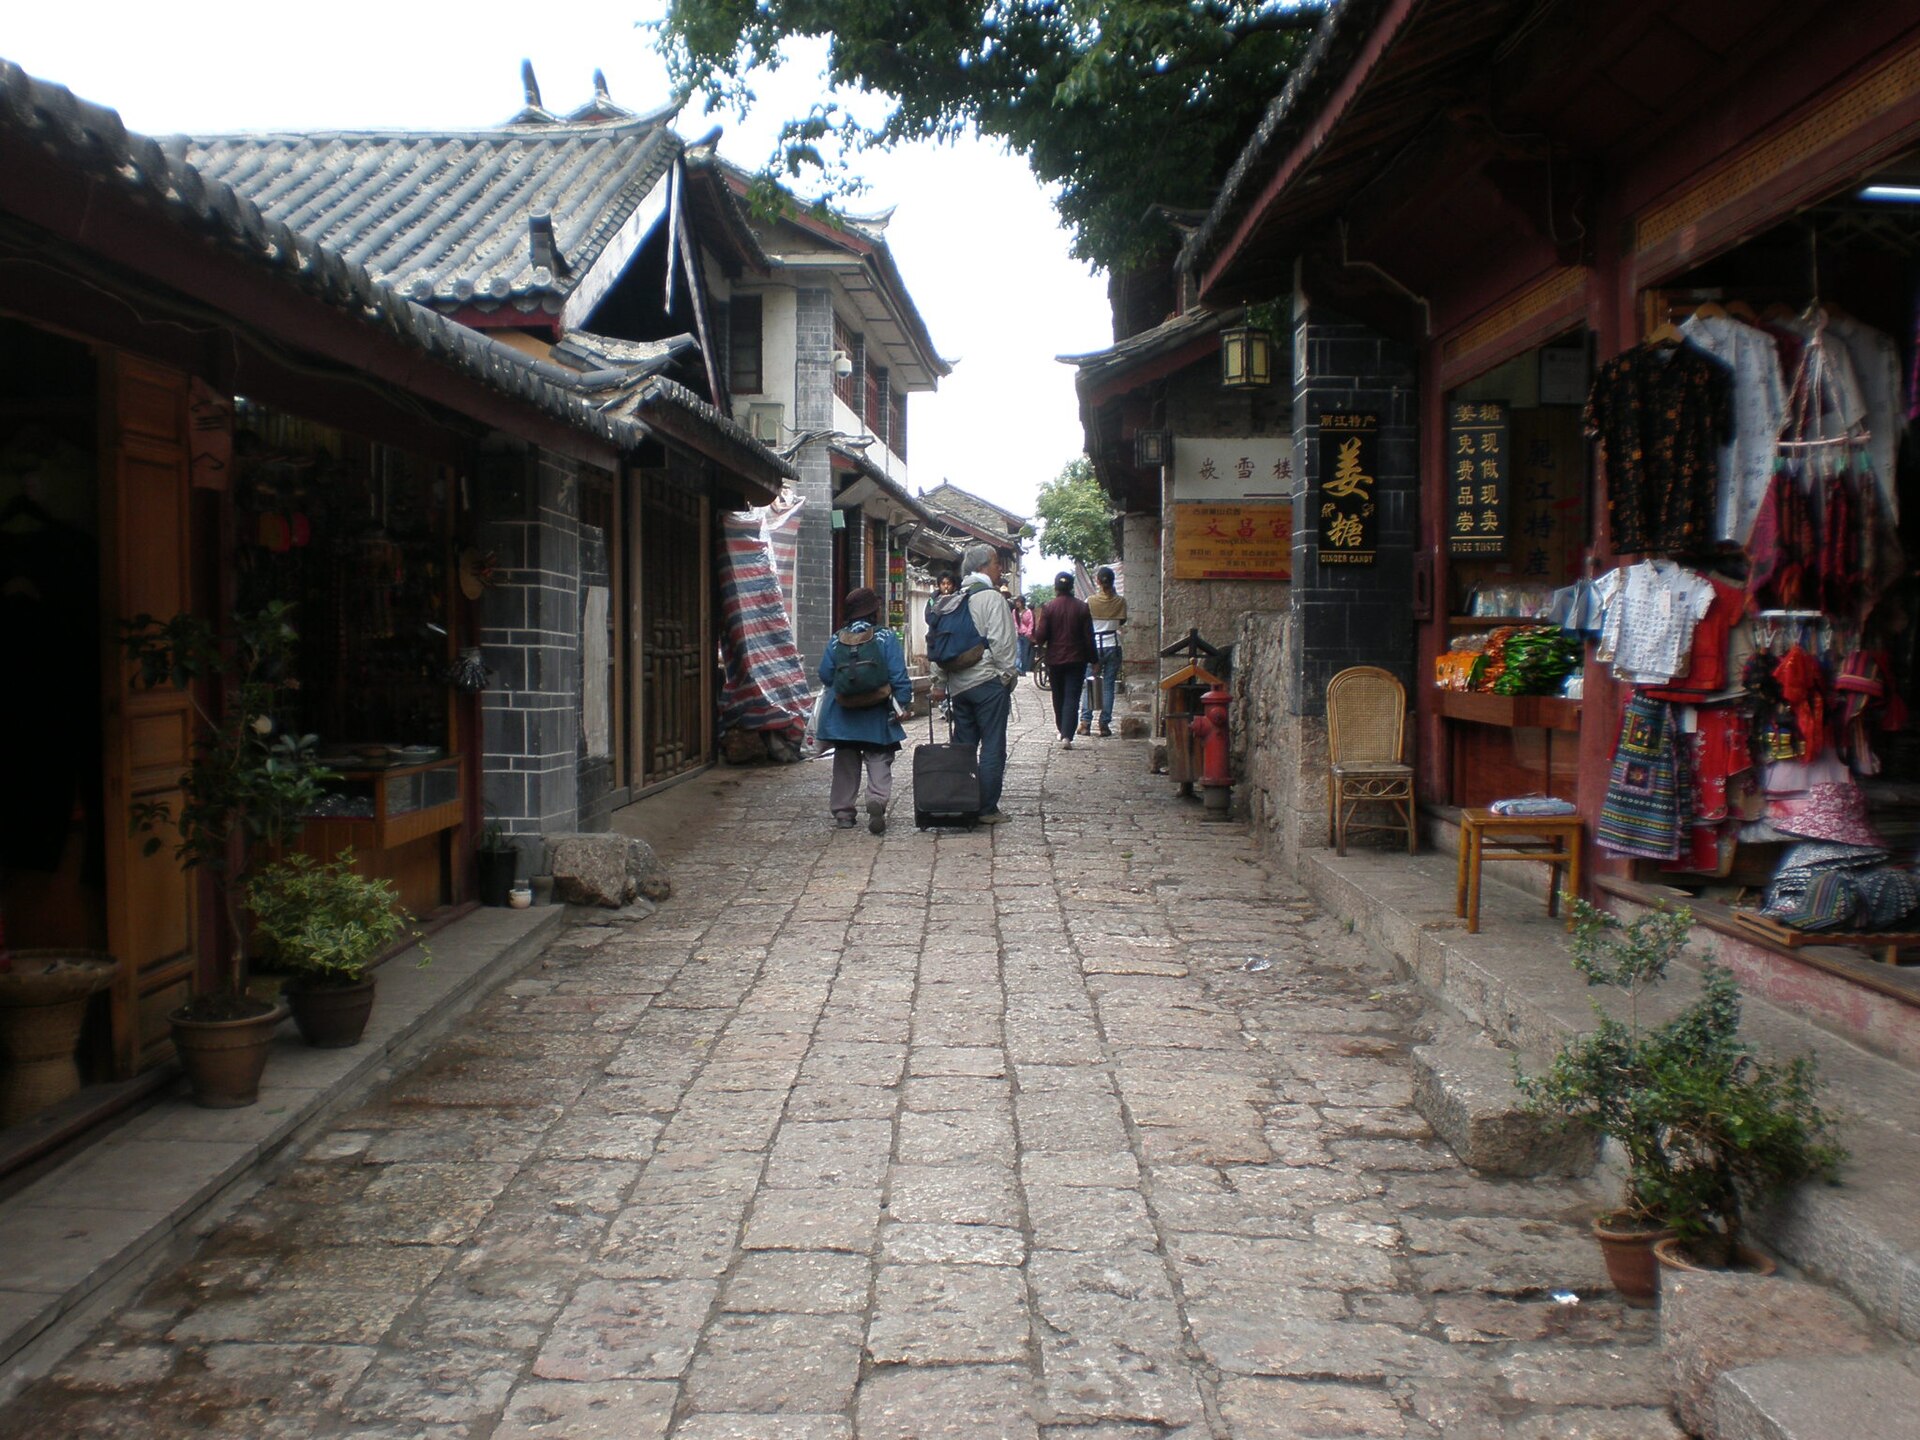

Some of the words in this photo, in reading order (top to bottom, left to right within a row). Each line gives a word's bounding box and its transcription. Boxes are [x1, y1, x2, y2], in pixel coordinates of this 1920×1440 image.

[1319, 414, 1377, 428] 丽江特产
[1455, 404, 1503, 422] 姜糖
[1198, 457, 1293, 480] 嵌雪楼
[1321, 435, 1374, 547] 姜糖
[1455, 434, 1476, 532] 免费品尝
[1480, 432, 1500, 532] 现做现卖
[1320, 554, 1347, 563] GINGER
[1349, 555, 1373, 563] CANDY
